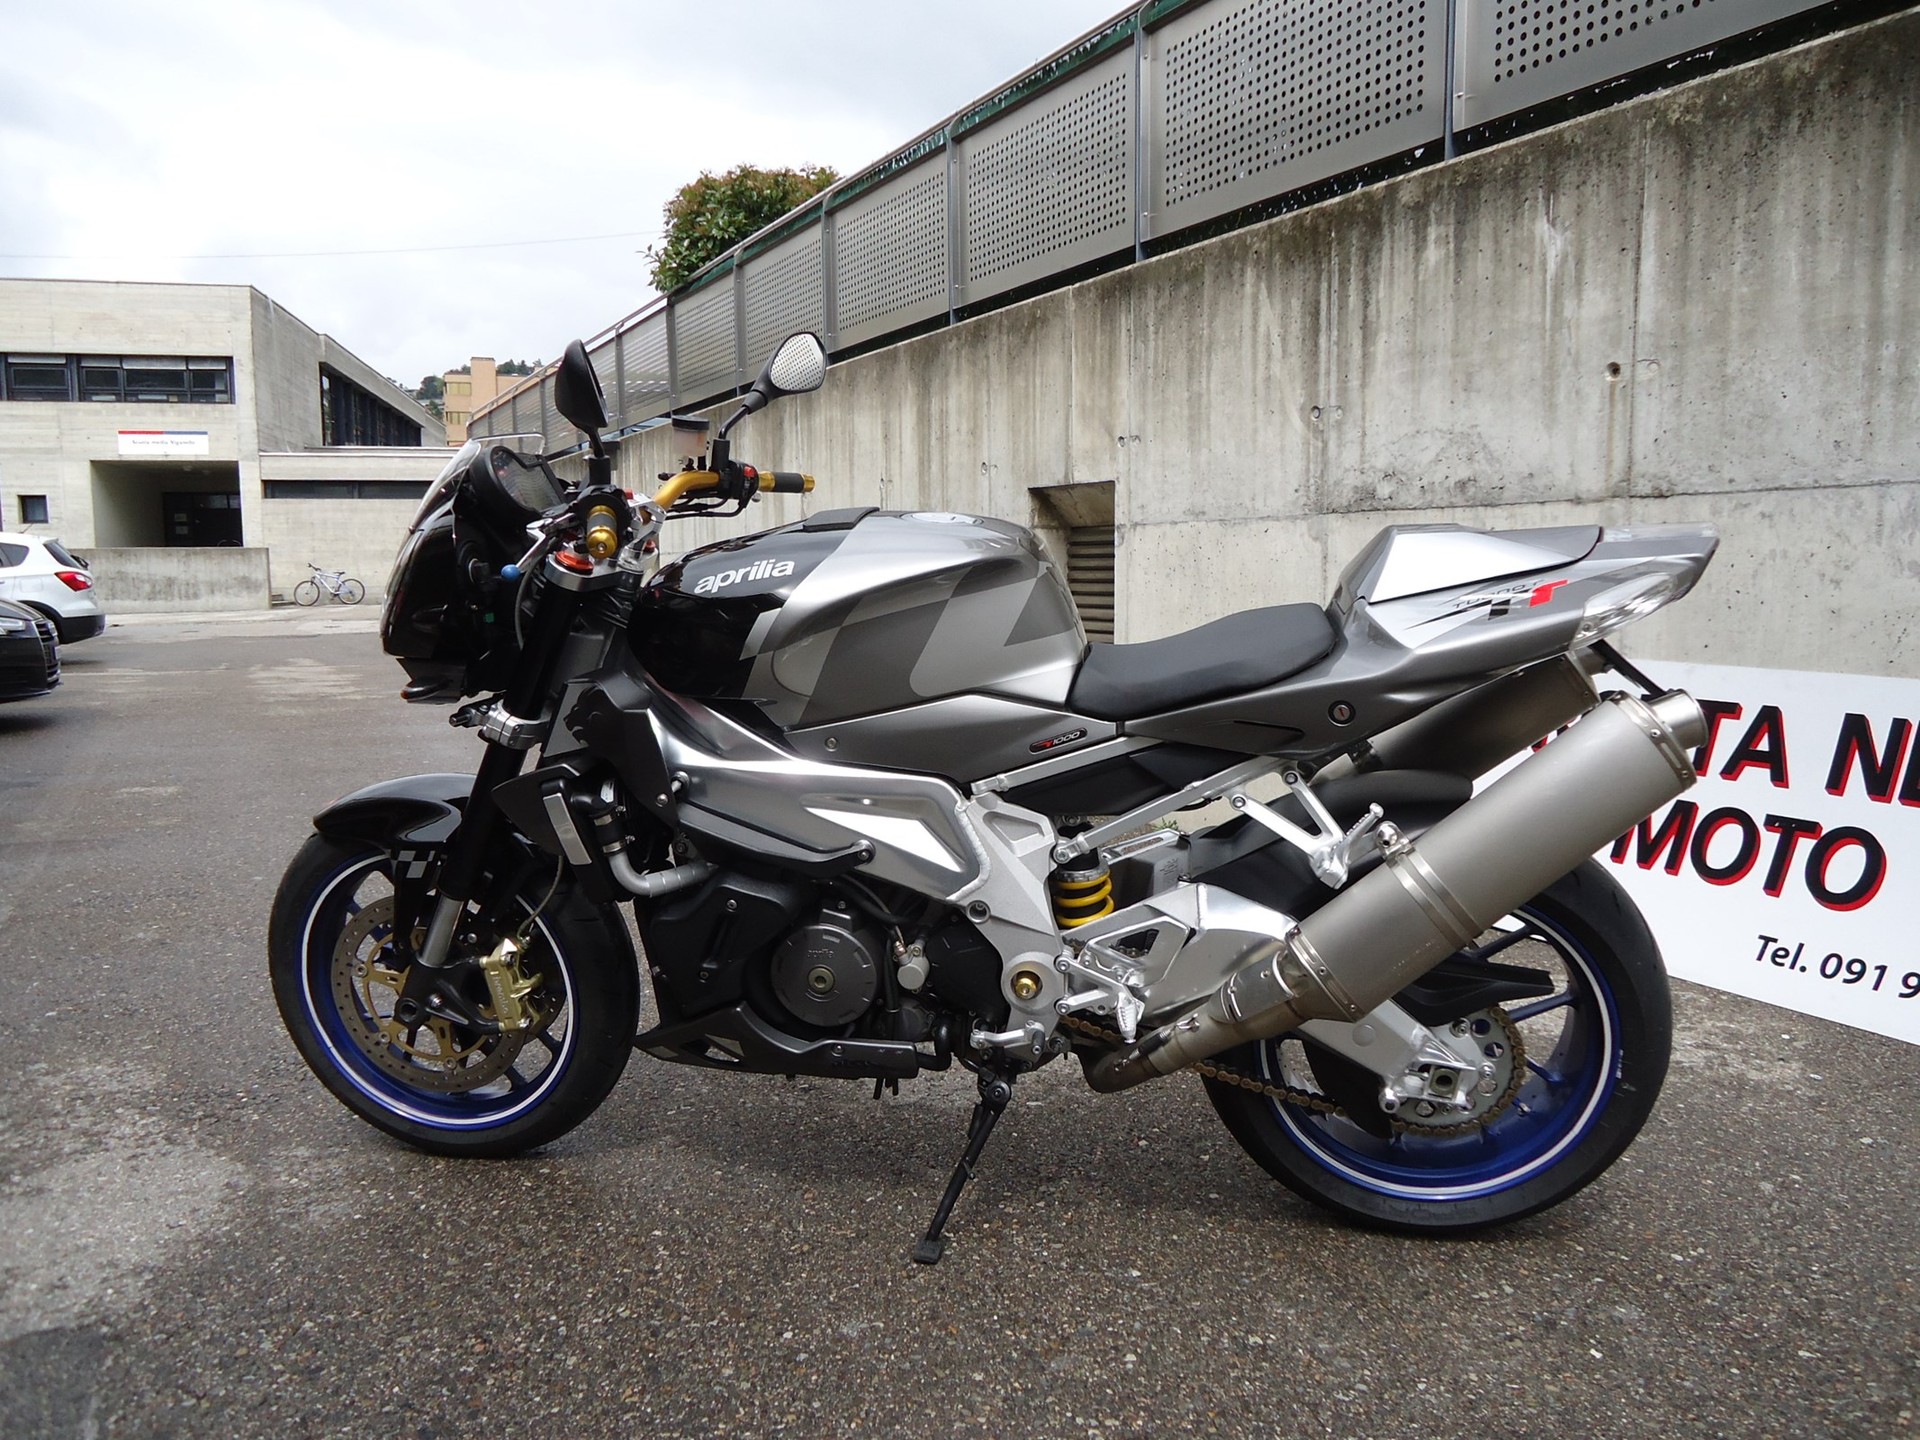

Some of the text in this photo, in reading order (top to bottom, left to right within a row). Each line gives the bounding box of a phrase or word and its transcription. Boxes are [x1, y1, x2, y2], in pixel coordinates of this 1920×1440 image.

[694, 559, 795, 594] aprilia
[1691, 698, 1789, 789] TA
[1610, 799, 1887, 911] MOTO
[1755, 934, 1807, 973] Tel.
[1819, 952, 1888, 991] 091
